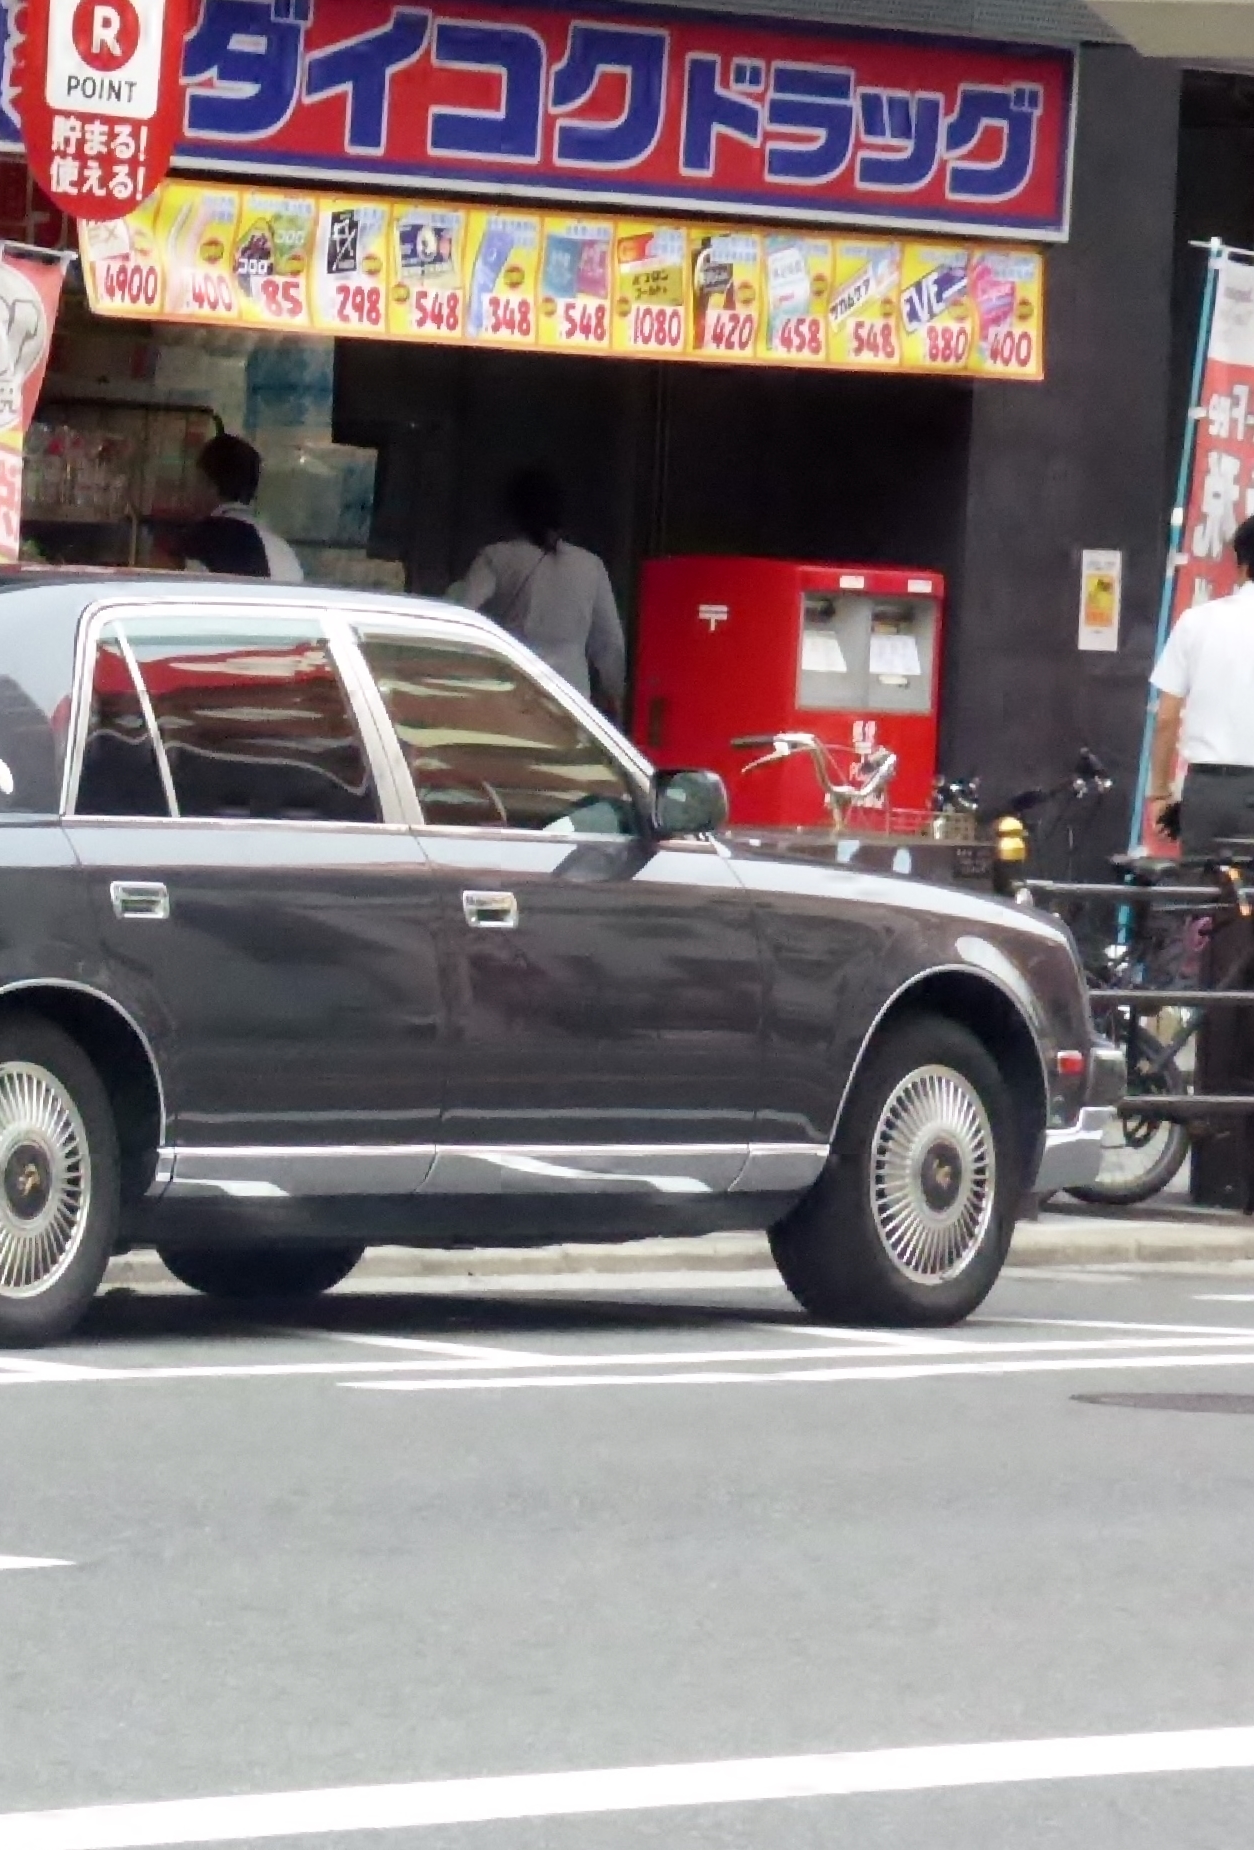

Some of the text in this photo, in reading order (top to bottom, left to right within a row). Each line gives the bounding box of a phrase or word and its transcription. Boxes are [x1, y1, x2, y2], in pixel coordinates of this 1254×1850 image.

[91, 5, 123, 57] R
[66, 74, 137, 103] POINT
[180, 0, 1045, 204] ダイコクドラッグ
[50, 115, 148, 162] 貯まる!
[49, 156, 146, 201] 使える!
[104, 263, 158, 306] 4900
[192, 273, 233, 312] 400
[260, 278, 303, 318] 85
[335, 284, 382, 326] 298
[414, 290, 459, 332] 548
[488, 296, 531, 337] 348
[563, 302, 607, 342] 548
[633, 307, 682, 347] 1080
[710, 312, 754, 351] 420
[779, 317, 823, 356] 458
[852, 320, 896, 359] 548
[926, 325, 969, 363] 880
[989, 329, 1033, 368] 400
